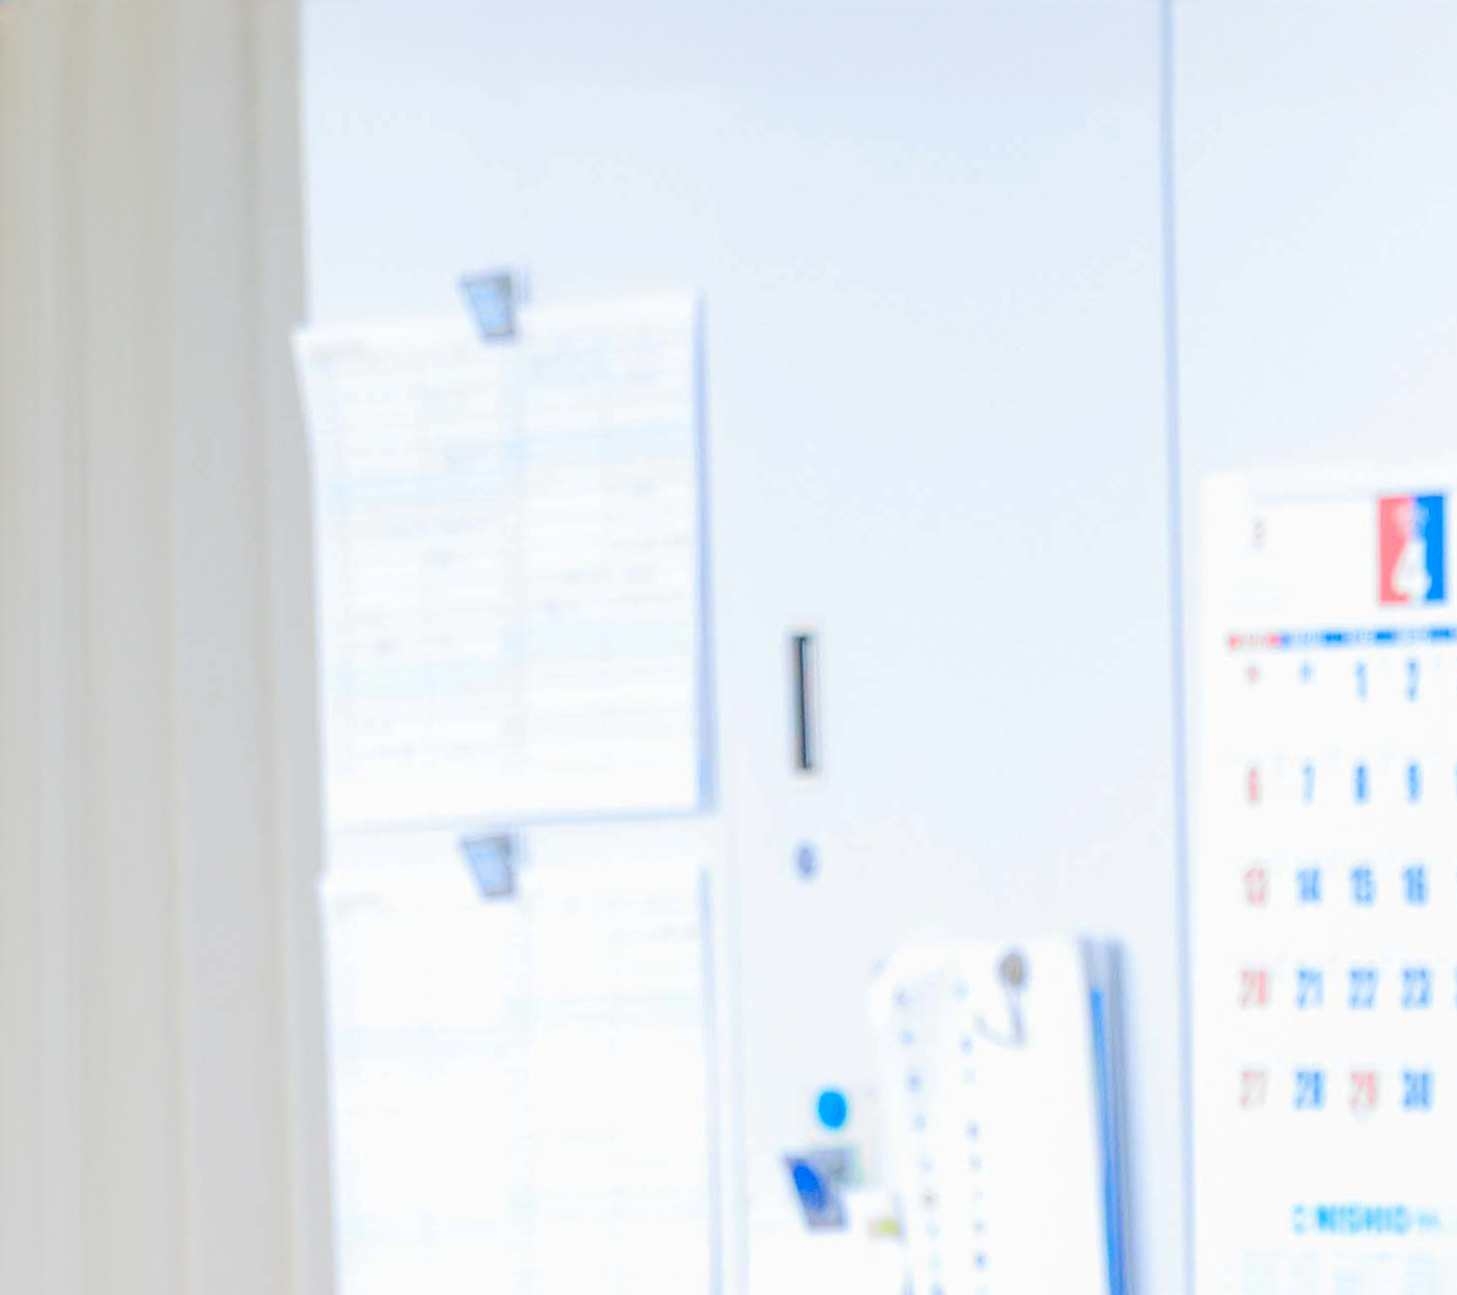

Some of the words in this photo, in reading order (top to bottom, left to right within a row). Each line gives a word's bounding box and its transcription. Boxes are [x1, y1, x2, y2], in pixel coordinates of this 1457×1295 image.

[1246, 764, 1263, 804] 6
[1301, 760, 1316, 803] 7
[1351, 760, 1371, 805] 8
[1404, 760, 1423, 805] 9
[1243, 865, 1269, 906] 13
[1295, 864, 1325, 905] 14
[1348, 862, 1377, 907] 15
[1400, 862, 1430, 907] 16
[1239, 967, 1274, 1008] 20
[1296, 964, 1325, 1010] 21
[1347, 964, 1381, 1010] 22
[1400, 964, 1434, 1010] 23
[1239, 1068, 1267, 1107] 27
[1292, 1065, 1327, 1110] 28
[1348, 1068, 1380, 1110] 29
[1400, 1065, 1435, 1112] 30
